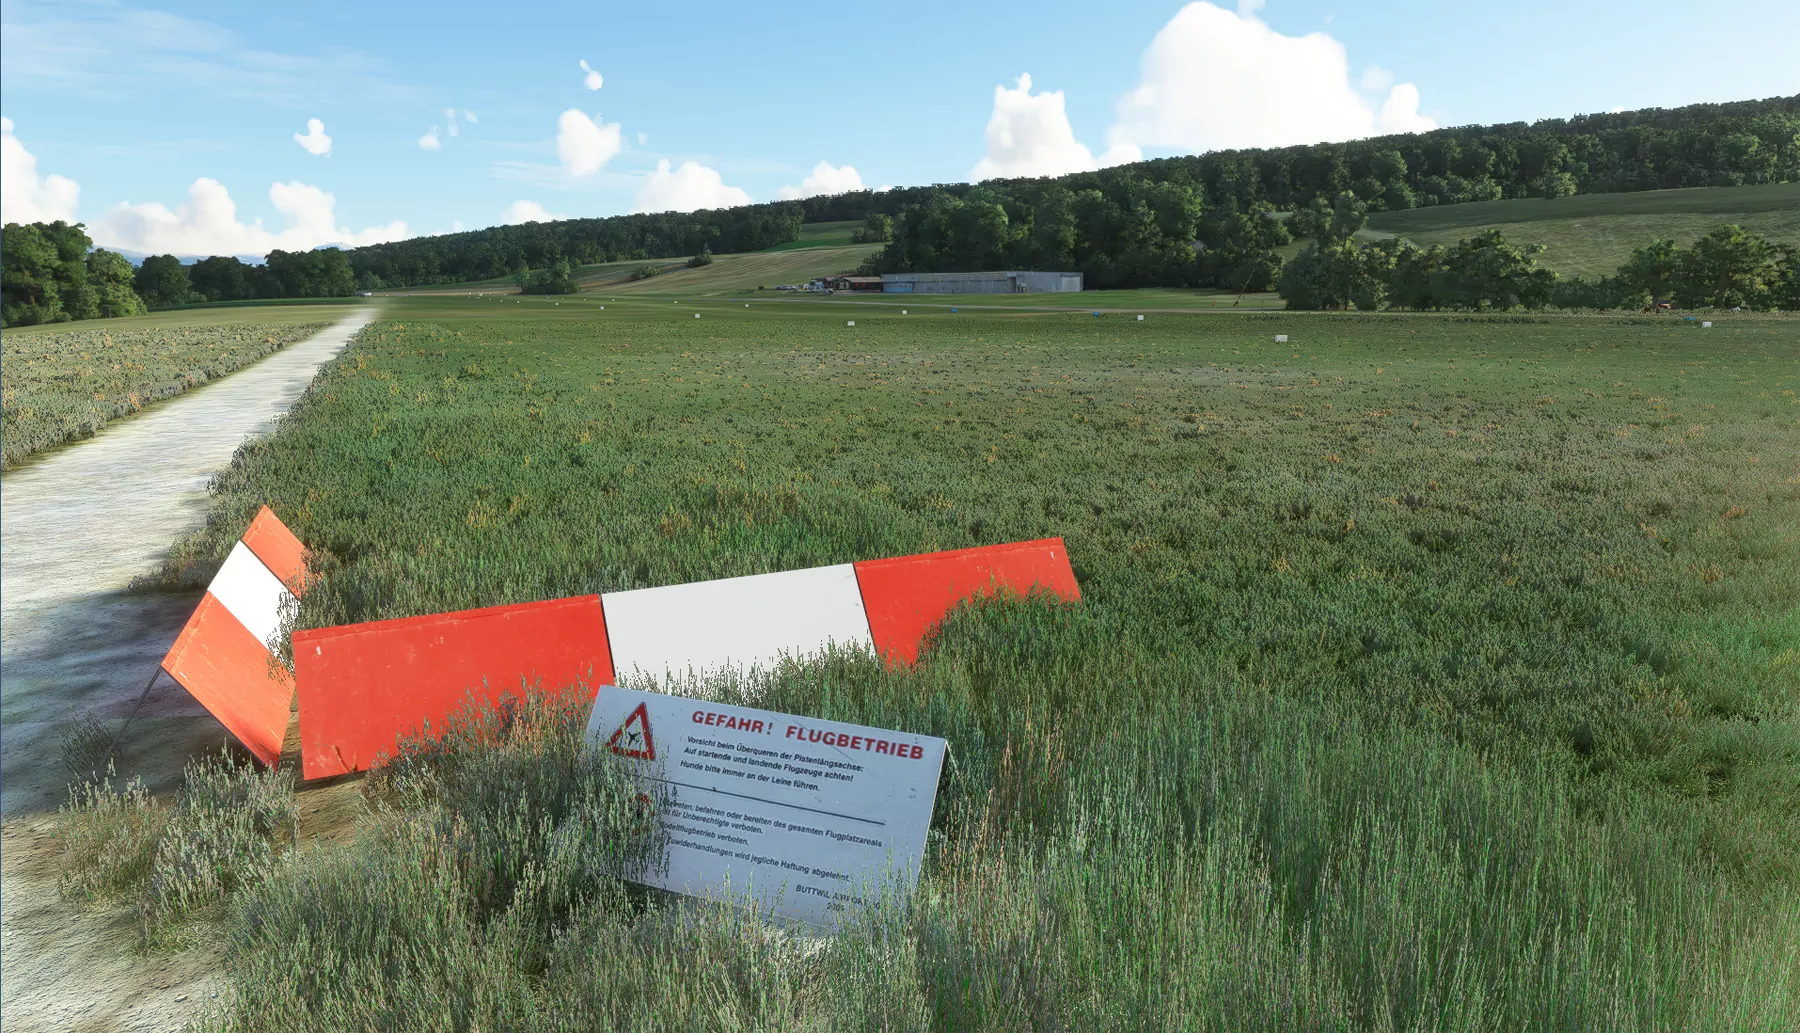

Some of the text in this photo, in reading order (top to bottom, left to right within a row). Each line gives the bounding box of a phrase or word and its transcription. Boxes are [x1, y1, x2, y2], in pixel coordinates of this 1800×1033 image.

[692, 711, 924, 760] GEFAHR! FLUGBETRIEB
[684, 747, 854, 782] Auf startende und landende Flugzeuge achten!
[688, 736, 716, 747] Vorsicht
[717, 740, 735, 750] beim
[736, 743, 778, 758] Überqueren
[794, 754, 864, 772] Pistenlängsachse:
[680, 760, 703, 771] Hunde
[704, 764, 723, 774] bitte
[722, 767, 745, 778] immer
[757, 774, 770, 782] der
[771, 776, 792, 787] Leine
[793, 780, 820, 791] führen.
[671, 809, 682, 817] für
[682, 811, 730, 828] Unberechtigte
[731, 822, 764, 834] verboten.
[695, 805, 725, 816] befahren
[726, 811, 743, 820] oder
[743, 813, 772, 826] bereiten
[773, 820, 787, 829] des
[788, 824, 824, 836] gesamten
[824, 829, 883, 847] Flugplatzareals
[717, 833, 750, 846] verboten.
[734, 851, 751, 861] wird
[750, 854, 779, 867] jegliche
[780, 860, 810, 875] Haftung
